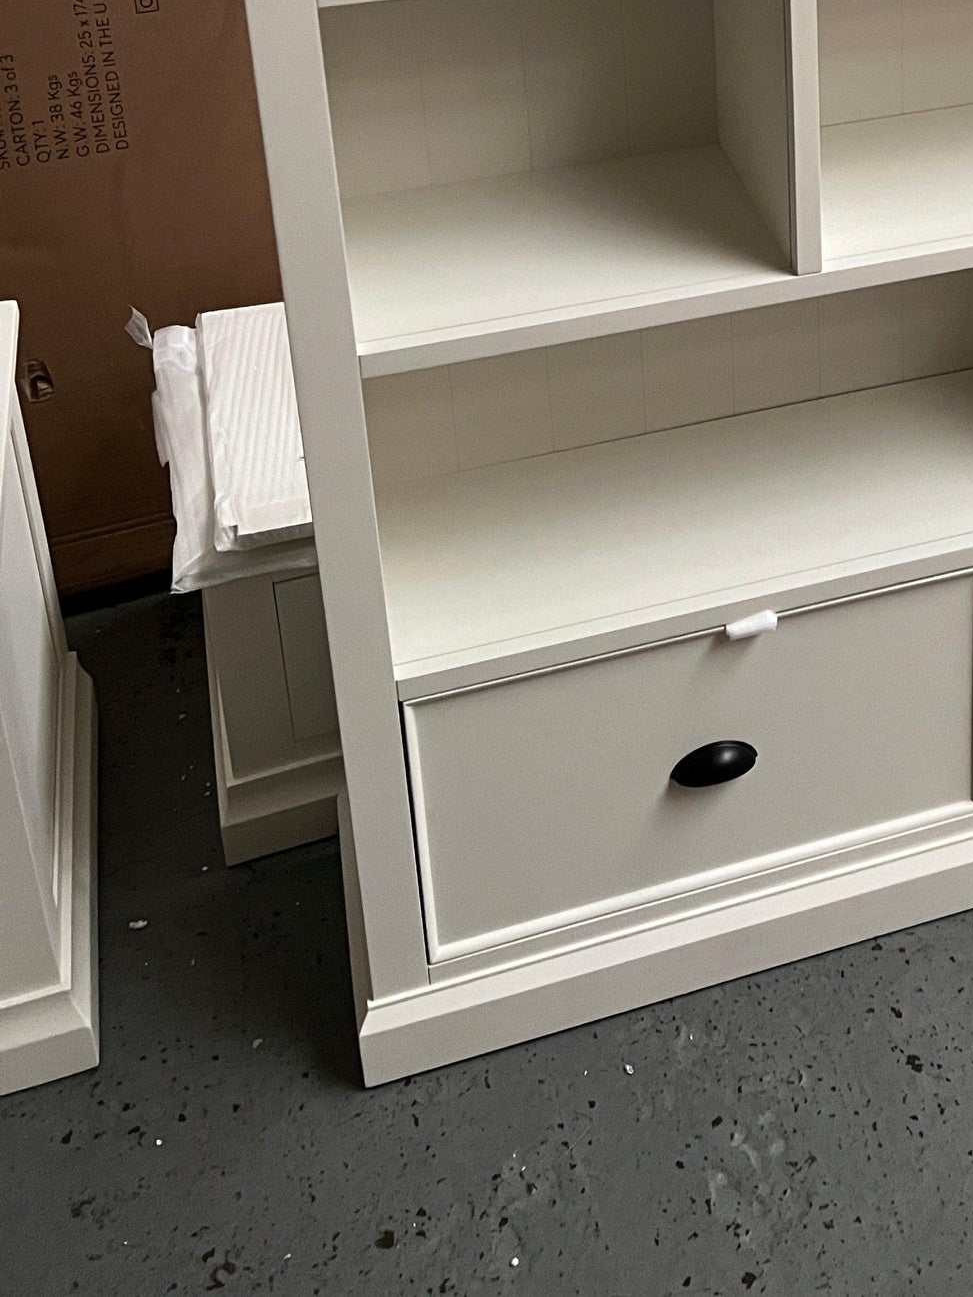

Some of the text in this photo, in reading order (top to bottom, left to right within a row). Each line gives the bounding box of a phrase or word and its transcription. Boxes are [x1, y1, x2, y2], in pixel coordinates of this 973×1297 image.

[78, 31, 93, 48] 25
[96, 18, 112, 47] THE
[1, 68, 16, 80] of
[101, 52, 115, 66] IN
[4, 85, 18, 93] 3
[82, 52, 110, 153] DIMENSIONS:
[47, 75, 69, 159] N.W: 38 Kgs
[67, 72, 89, 157] G.W: 46 Kgs
[105, 71, 129, 150] DESIGNED
[7, 95, 30, 166] CARTON:
[33, 128, 51, 163] QTY:
